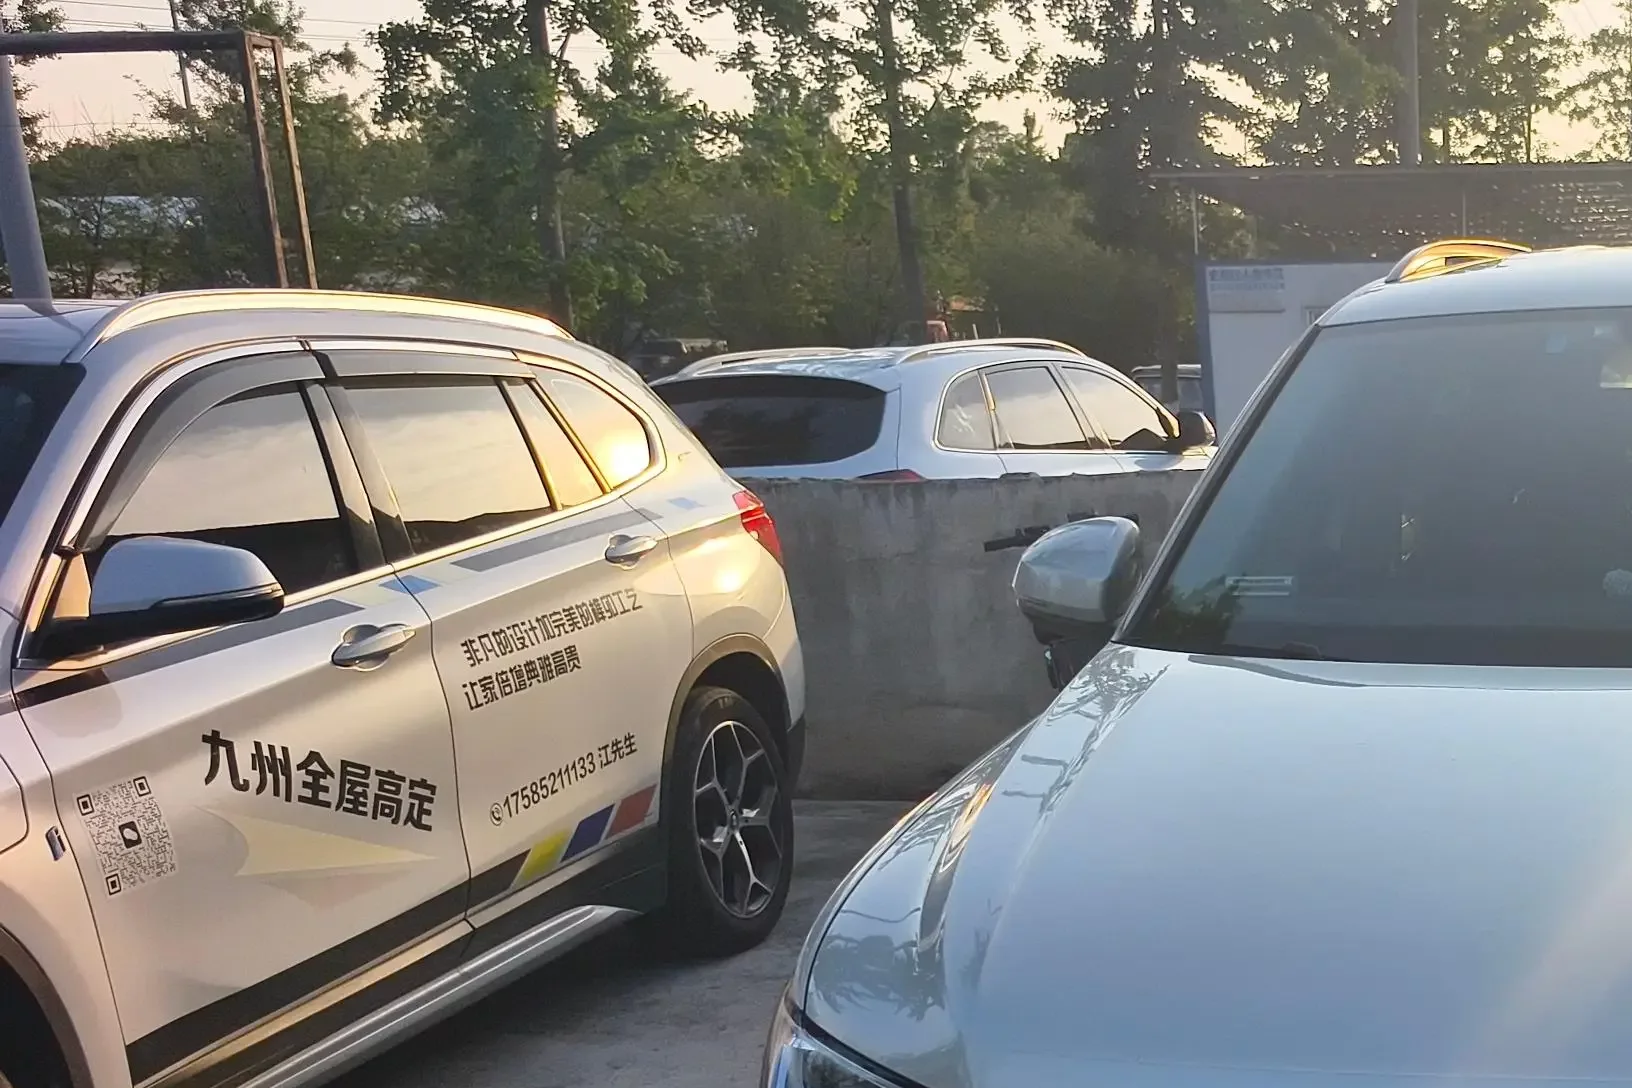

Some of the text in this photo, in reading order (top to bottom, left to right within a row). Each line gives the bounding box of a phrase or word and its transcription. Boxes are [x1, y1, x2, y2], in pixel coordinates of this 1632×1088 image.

[461, 644, 582, 711] 让家倍增典雅高贵
[201, 729, 437, 832] 九州全屋高定
[503, 732, 638, 819] 17585211133 江先生
